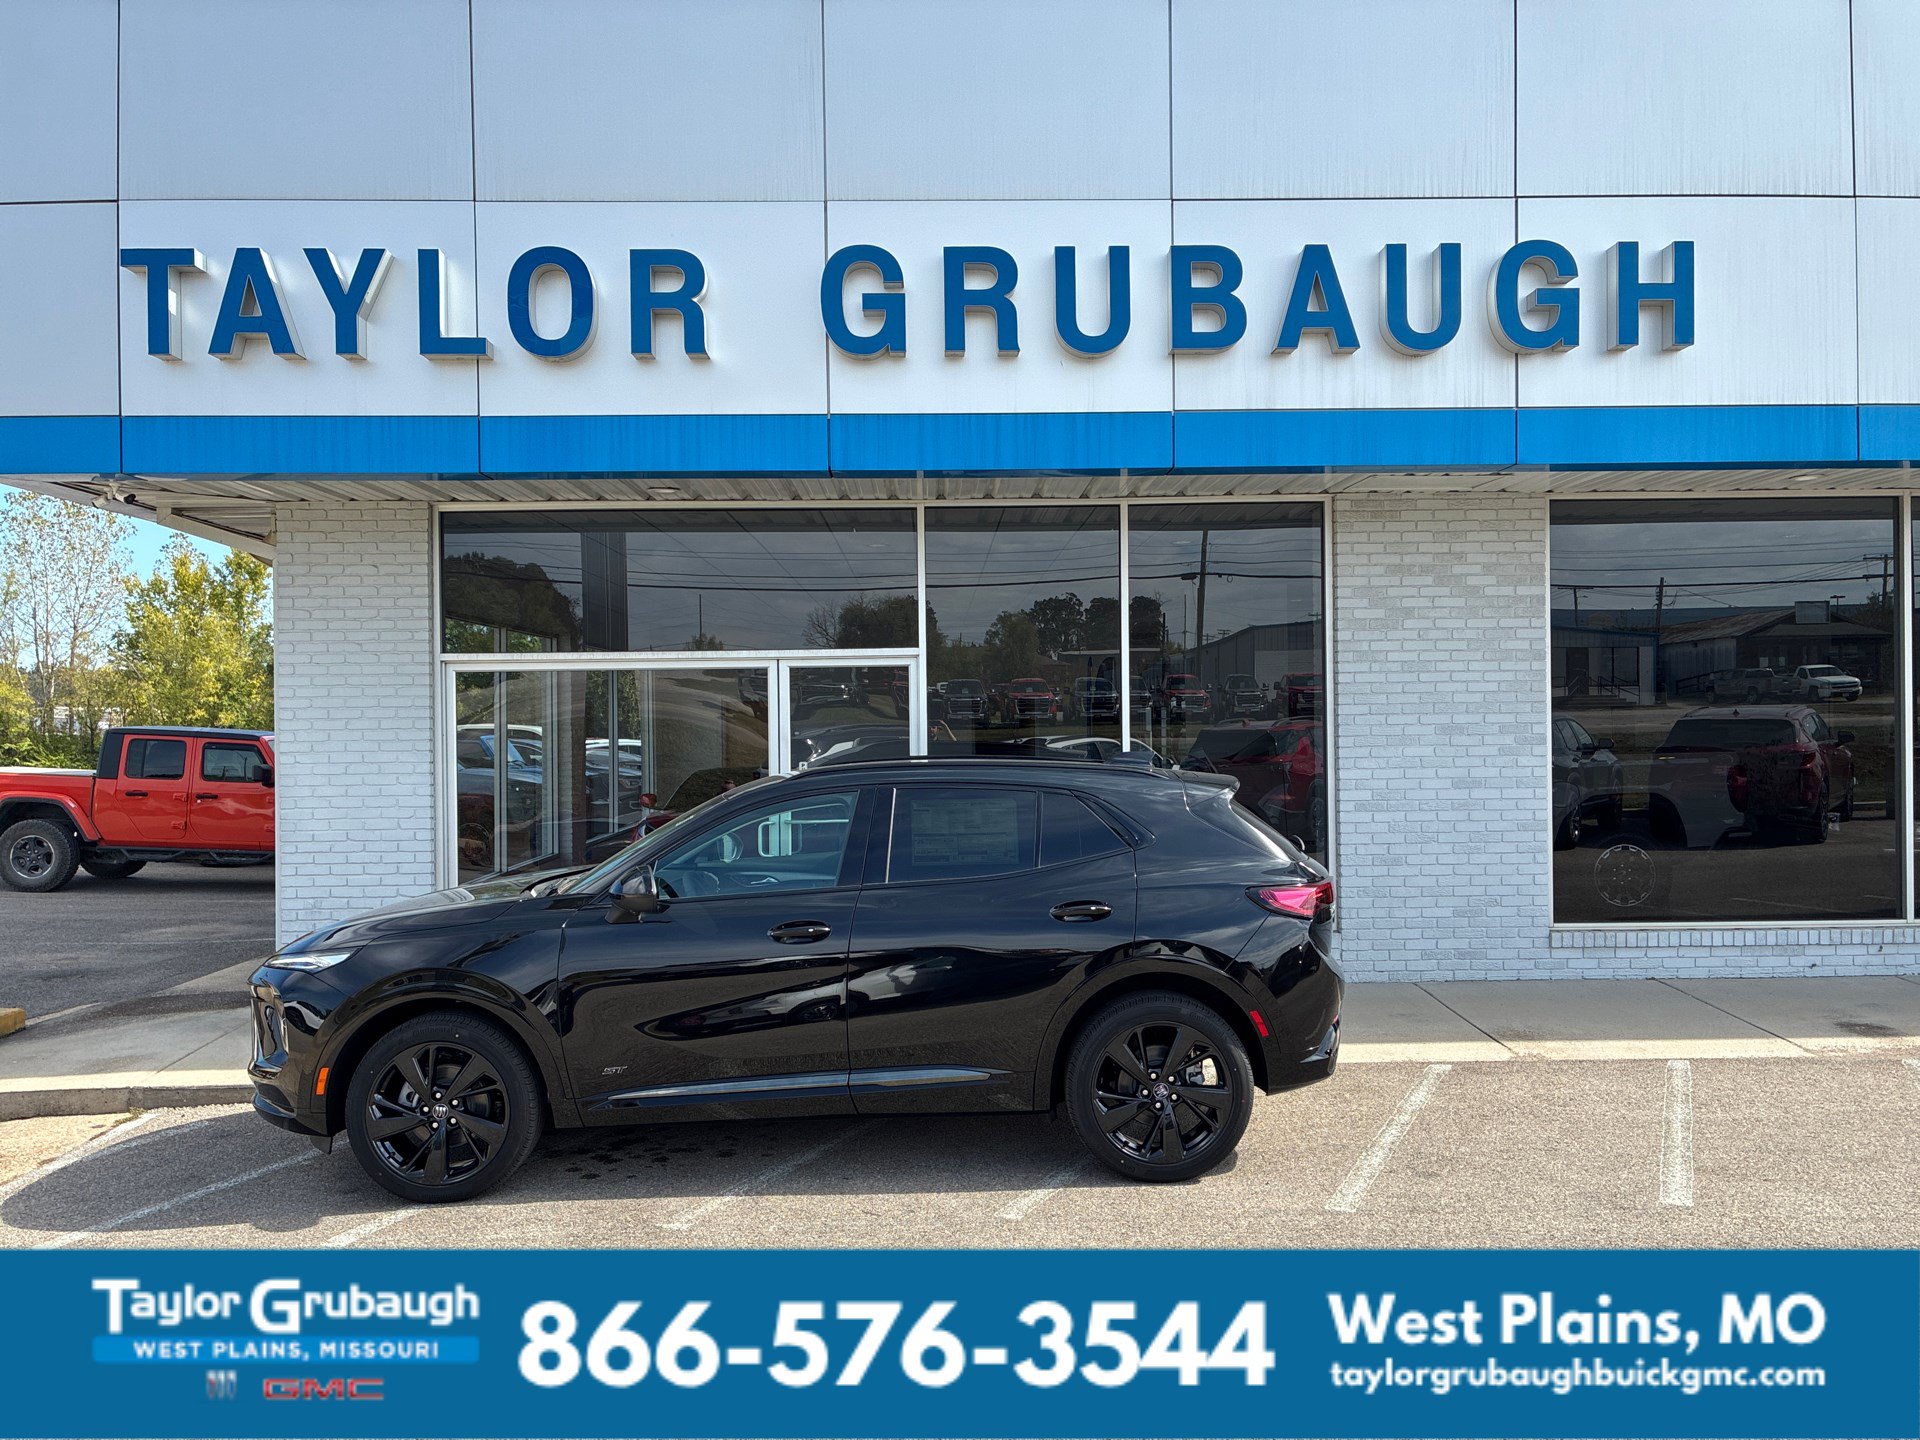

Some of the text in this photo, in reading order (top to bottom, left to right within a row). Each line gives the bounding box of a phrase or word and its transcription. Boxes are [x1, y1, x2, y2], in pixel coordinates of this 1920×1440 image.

[119, 239, 1697, 360] TAYLOR GRUBAUGH
[601, 1065, 628, 1075] ST
